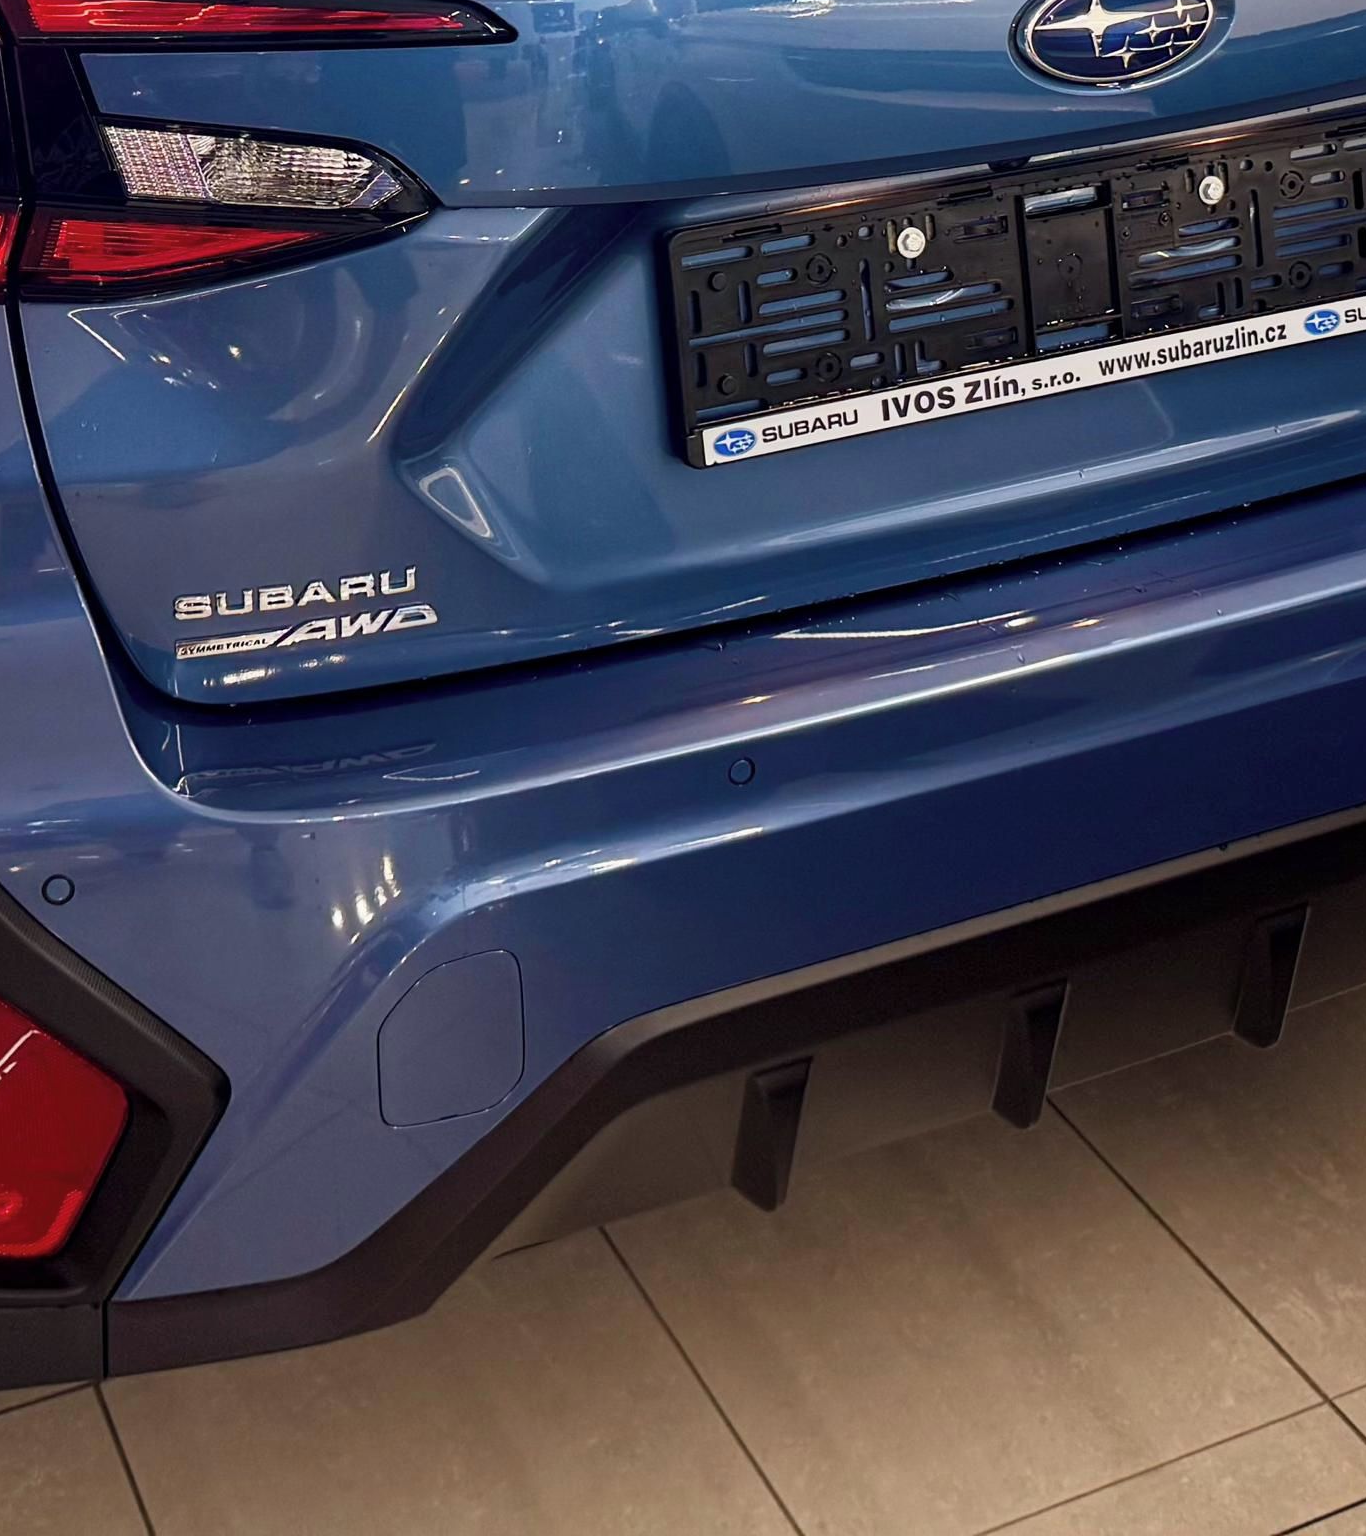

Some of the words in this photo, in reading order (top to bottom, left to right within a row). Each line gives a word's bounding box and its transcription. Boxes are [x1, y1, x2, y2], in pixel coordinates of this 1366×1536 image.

[762, 409, 859, 443] SUBARU
[881, 386, 956, 422] IVOS
[963, 376, 1026, 405] Zlín,
[1031, 371, 1081, 391] s.r.o.
[1098, 322, 1288, 377] www.subaruzlin.cz
[175, 565, 417, 621] SUBARU
[179, 637, 269, 657] SYMMETRICAL
[277, 603, 439, 648] AWD
